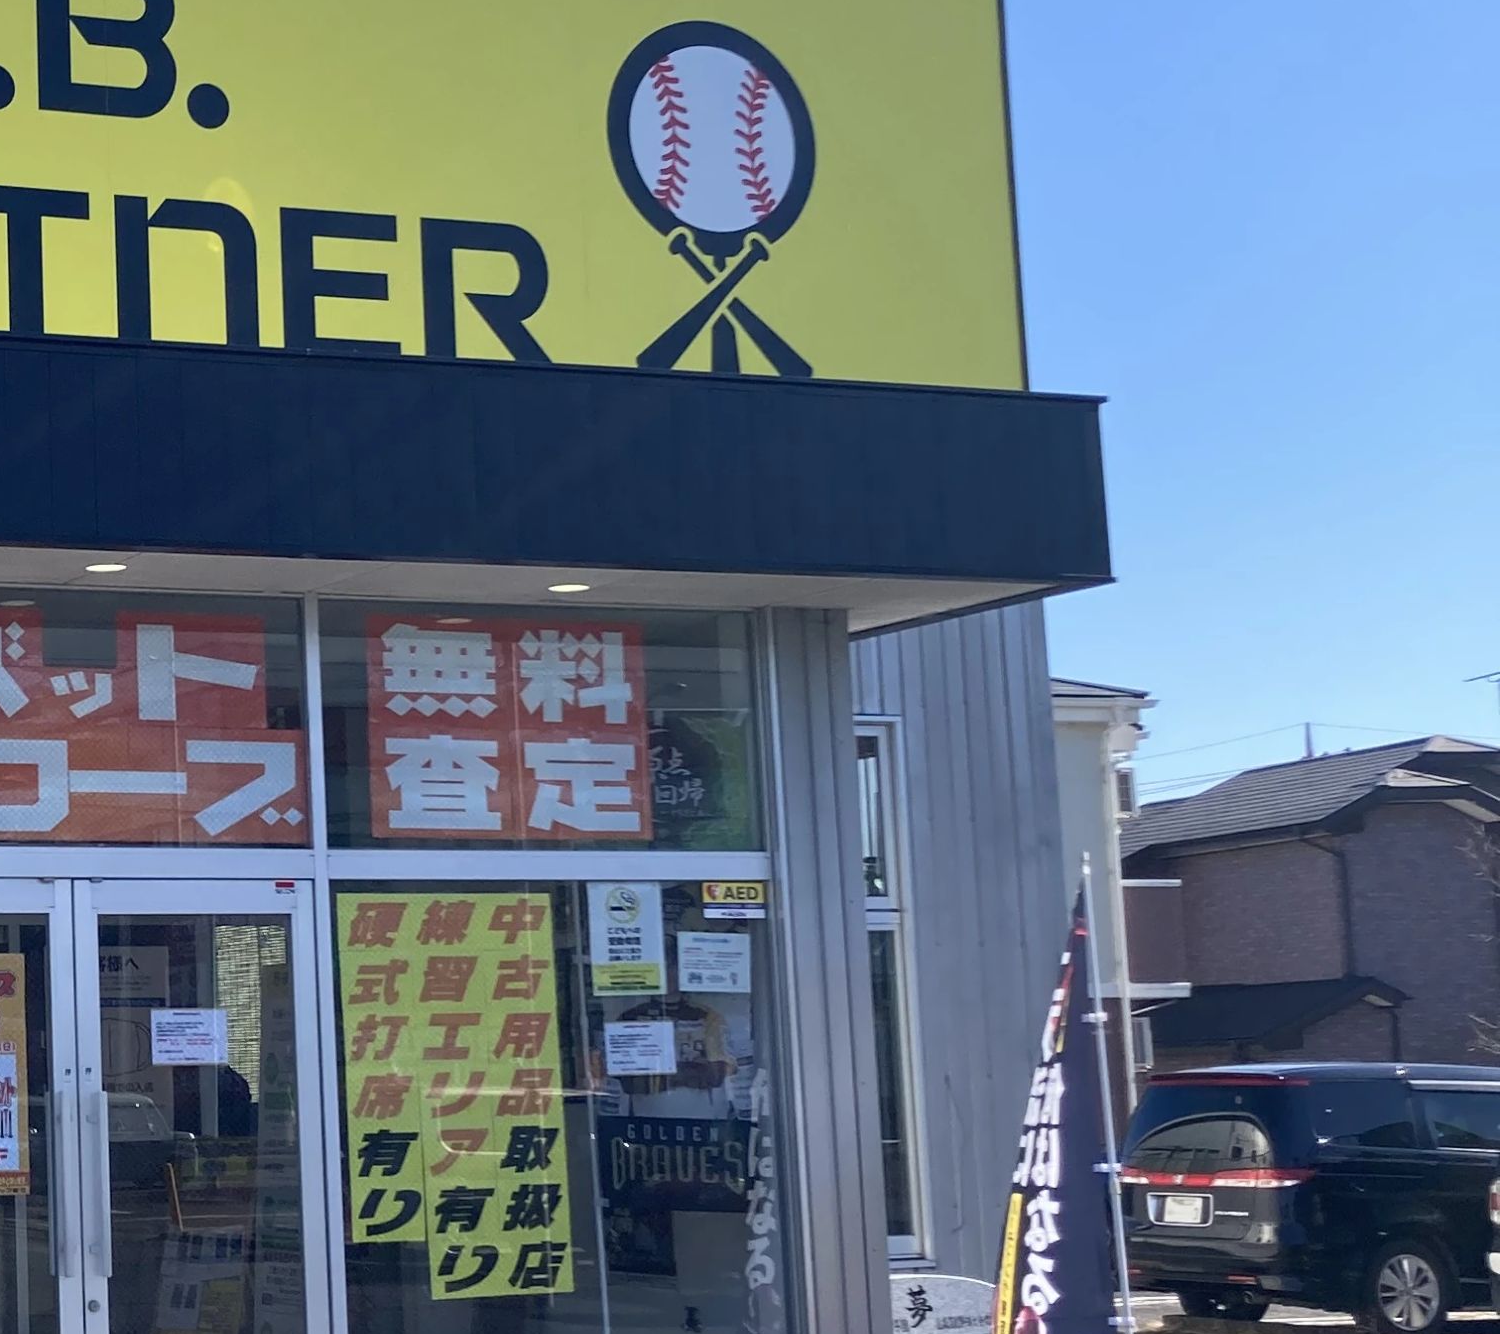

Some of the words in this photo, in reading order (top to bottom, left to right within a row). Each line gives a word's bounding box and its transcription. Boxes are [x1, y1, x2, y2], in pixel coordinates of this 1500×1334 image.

[381, 624, 633, 725] 無料
[383, 733, 641, 834] 査定
[722, 886, 759, 901] AED
[346, 899, 423, 1240] 硬式打席有り
[414, 898, 500, 1292] 練習エリア有り
[486, 896, 569, 1289] 中古用品取扱店
[905, 1284, 933, 1329] 夢
